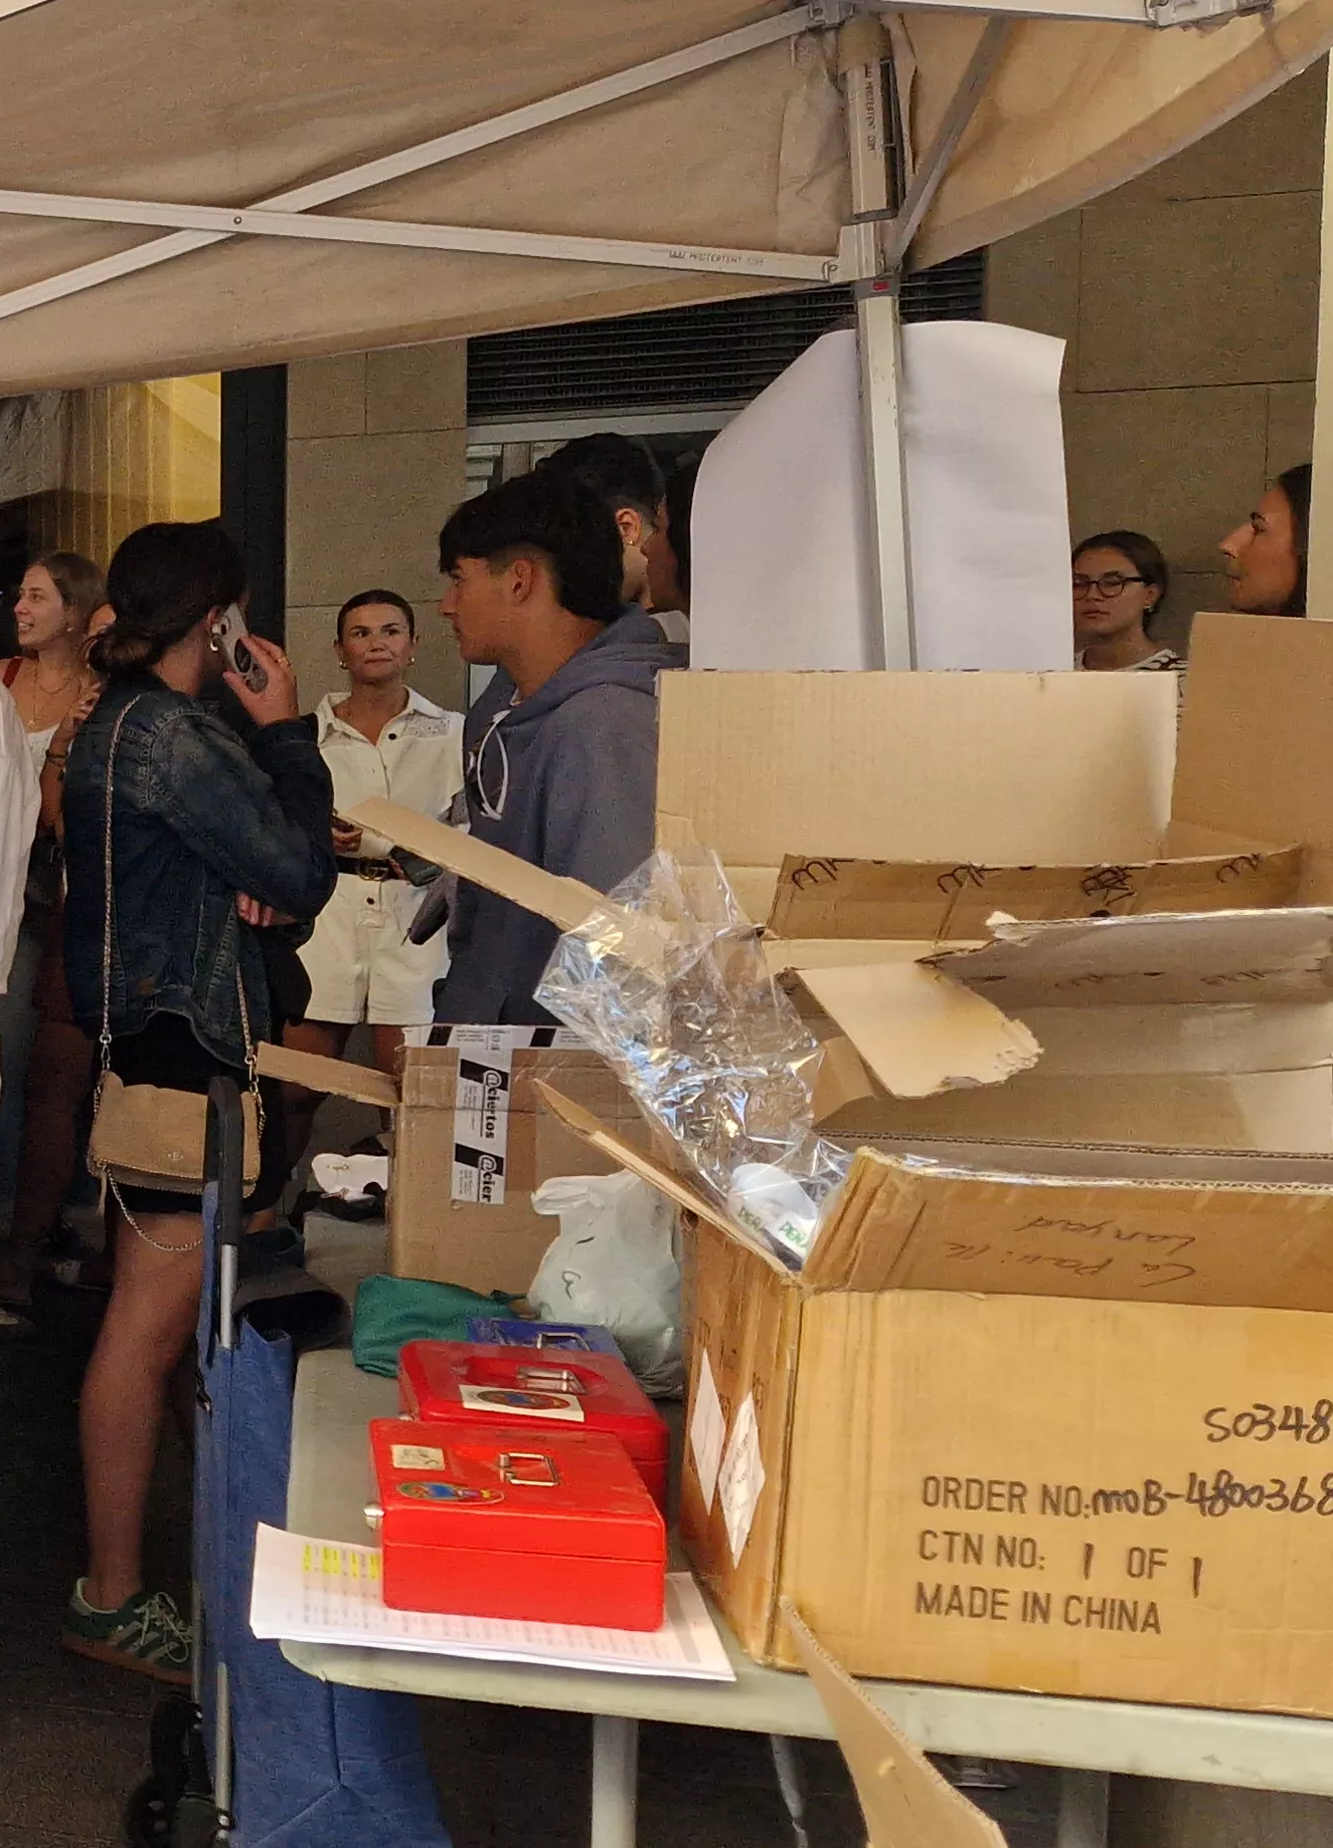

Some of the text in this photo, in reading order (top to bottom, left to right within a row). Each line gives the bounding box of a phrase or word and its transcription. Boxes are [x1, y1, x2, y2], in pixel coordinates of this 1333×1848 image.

[922, 1475, 1029, 1516] ORDER
[1040, 1482, 1090, 1520] NO:
[917, 1529, 984, 1567] CTN
[994, 1536, 1046, 1571] NO:
[1126, 1546, 1169, 1581] OF
[915, 1581, 1164, 1635] MADE IN CHINA
